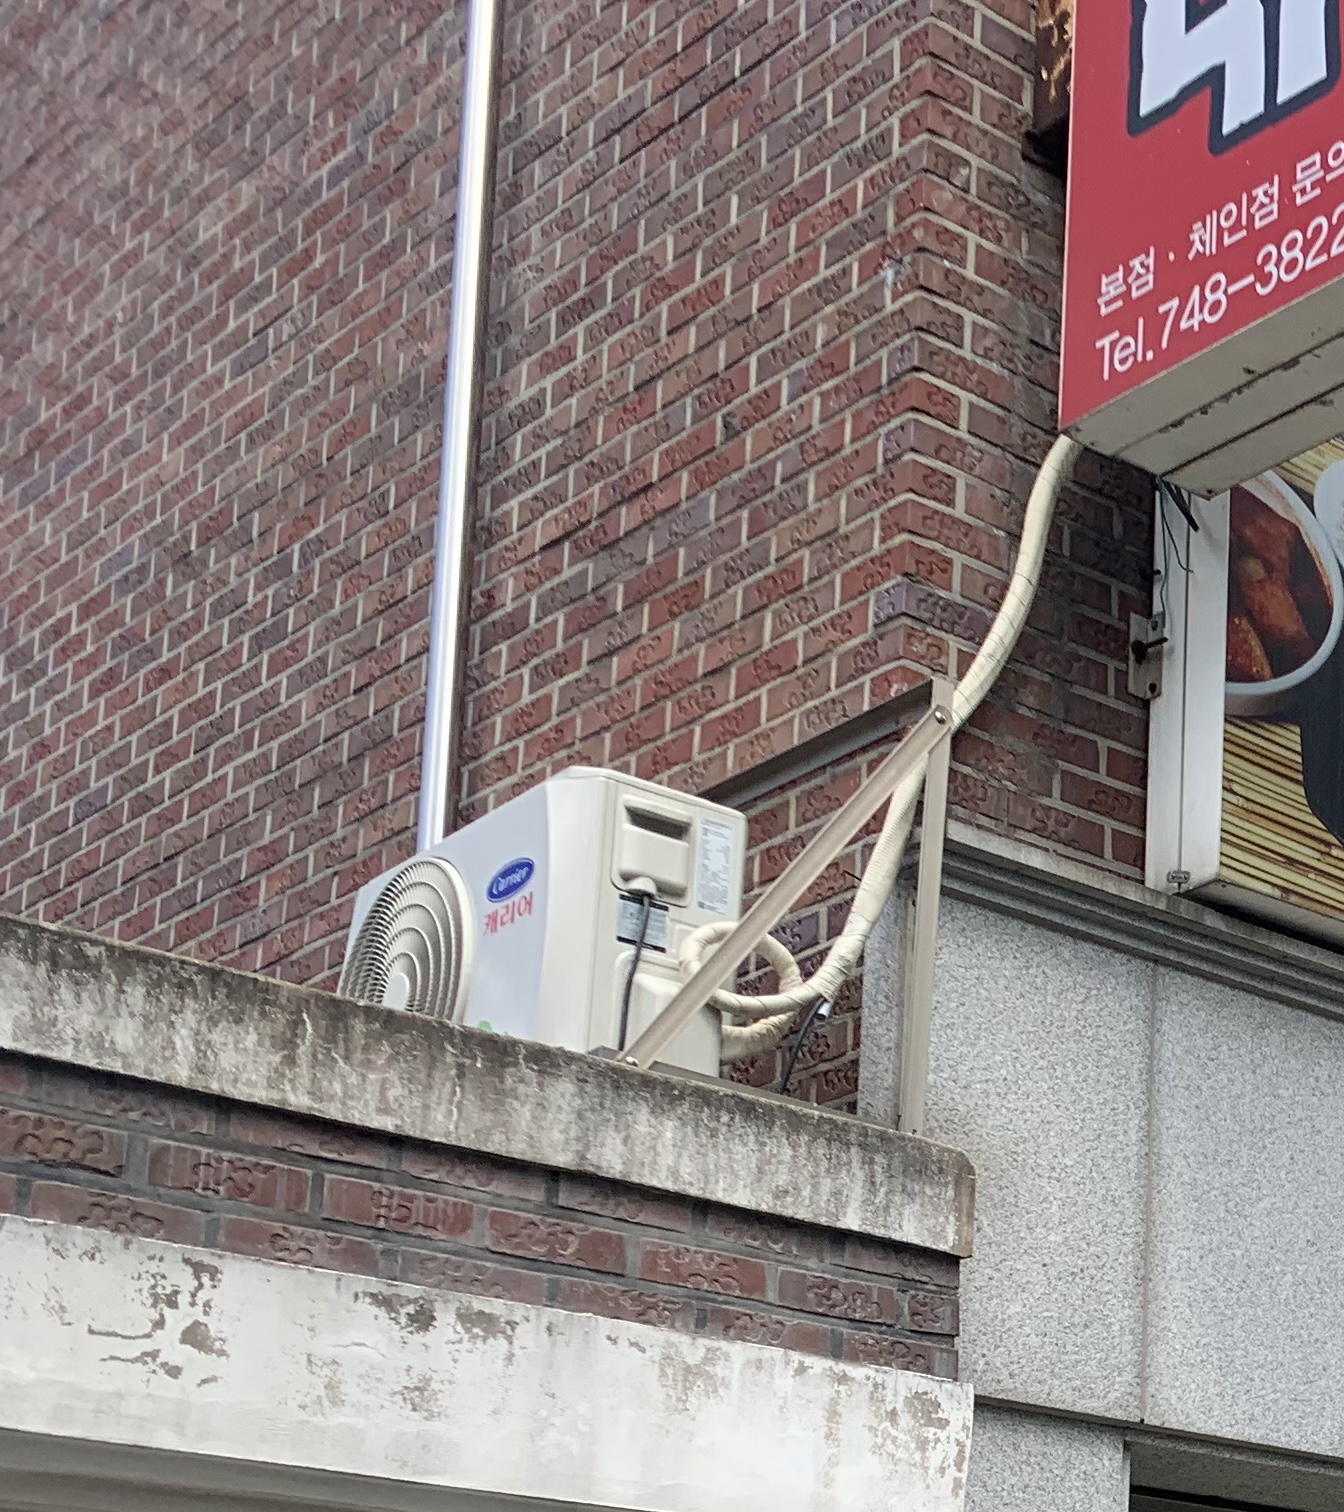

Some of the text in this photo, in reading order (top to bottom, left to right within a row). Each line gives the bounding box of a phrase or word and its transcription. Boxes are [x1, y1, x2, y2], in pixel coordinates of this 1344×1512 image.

[1096, 246, 1155, 317] 본점
[1187, 174, 1280, 264] 체인점
[483, 891, 533, 936] 캐리어
